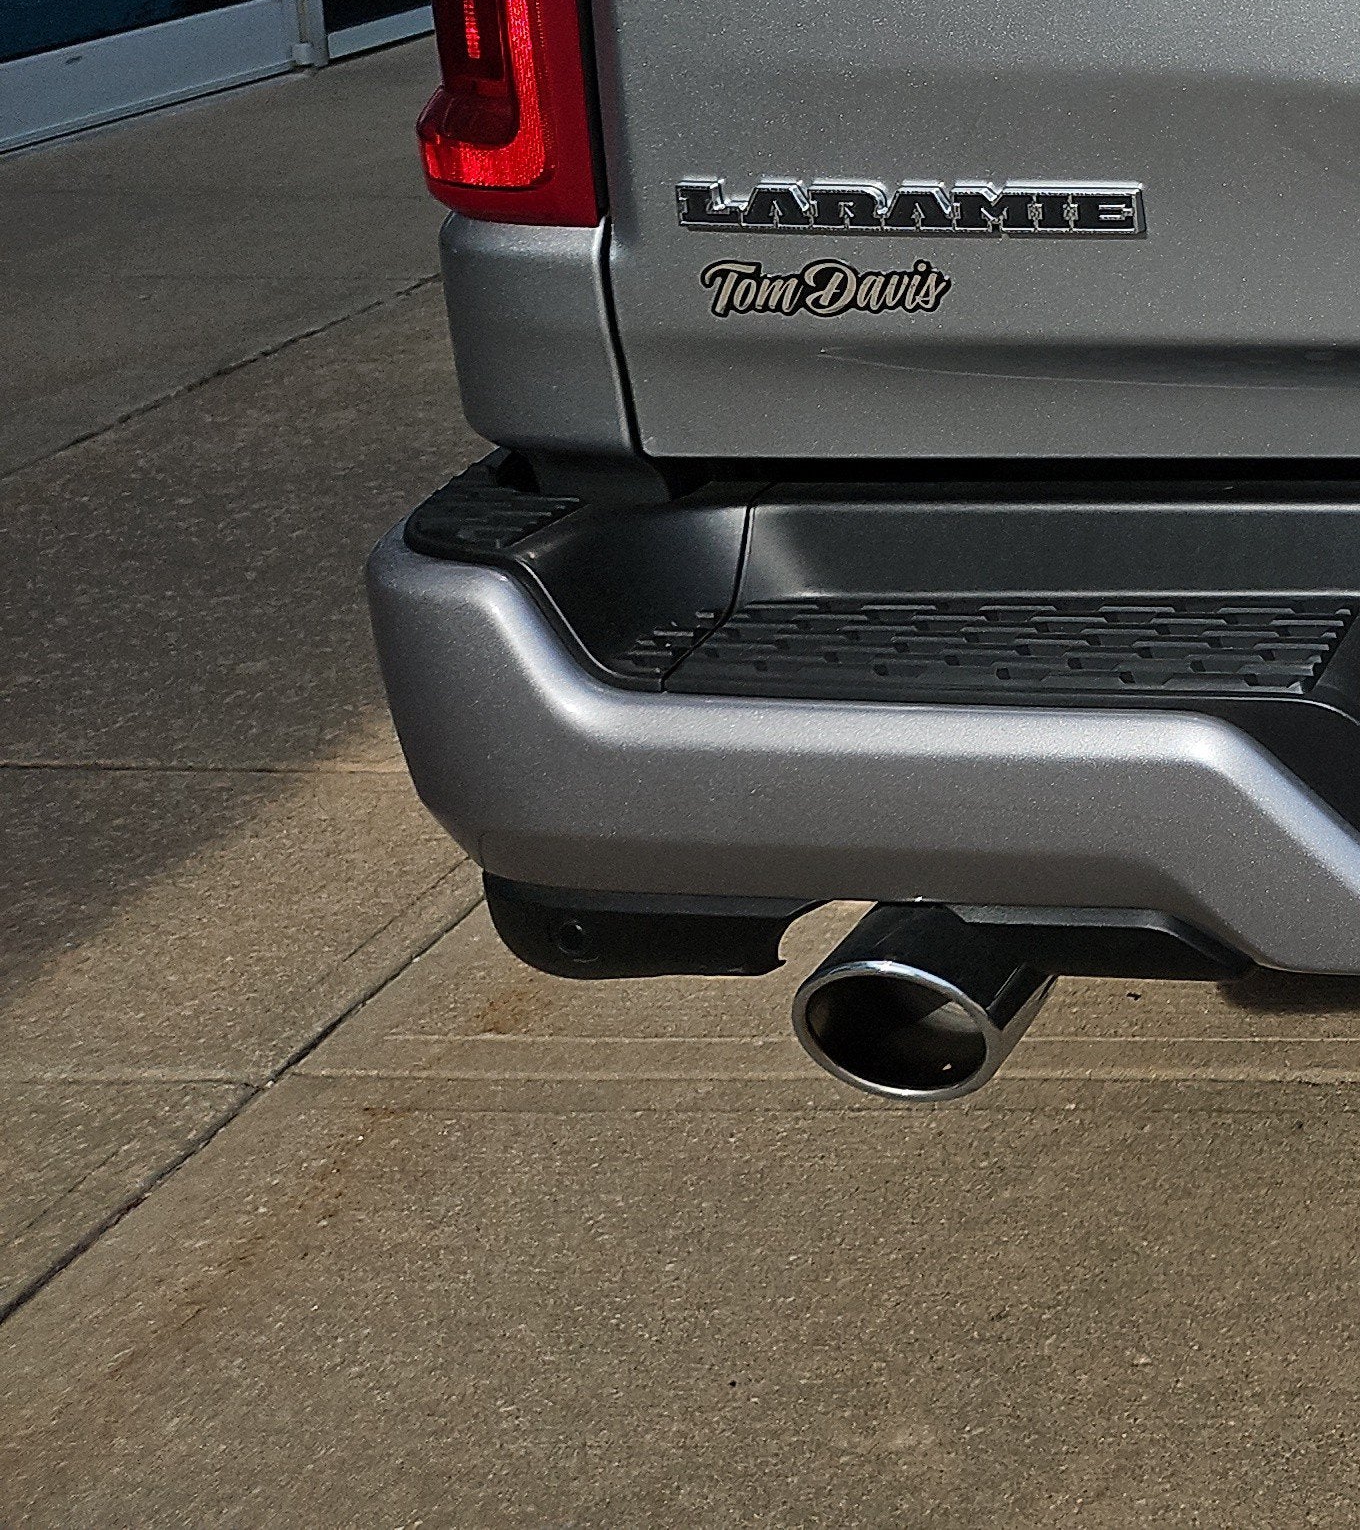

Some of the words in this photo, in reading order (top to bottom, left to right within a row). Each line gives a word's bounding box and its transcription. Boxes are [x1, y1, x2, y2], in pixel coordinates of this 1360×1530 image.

[675, 176, 1146, 236] LARAMIE
[701, 259, 800, 317] Tom
[801, 259, 951, 318] Davis
